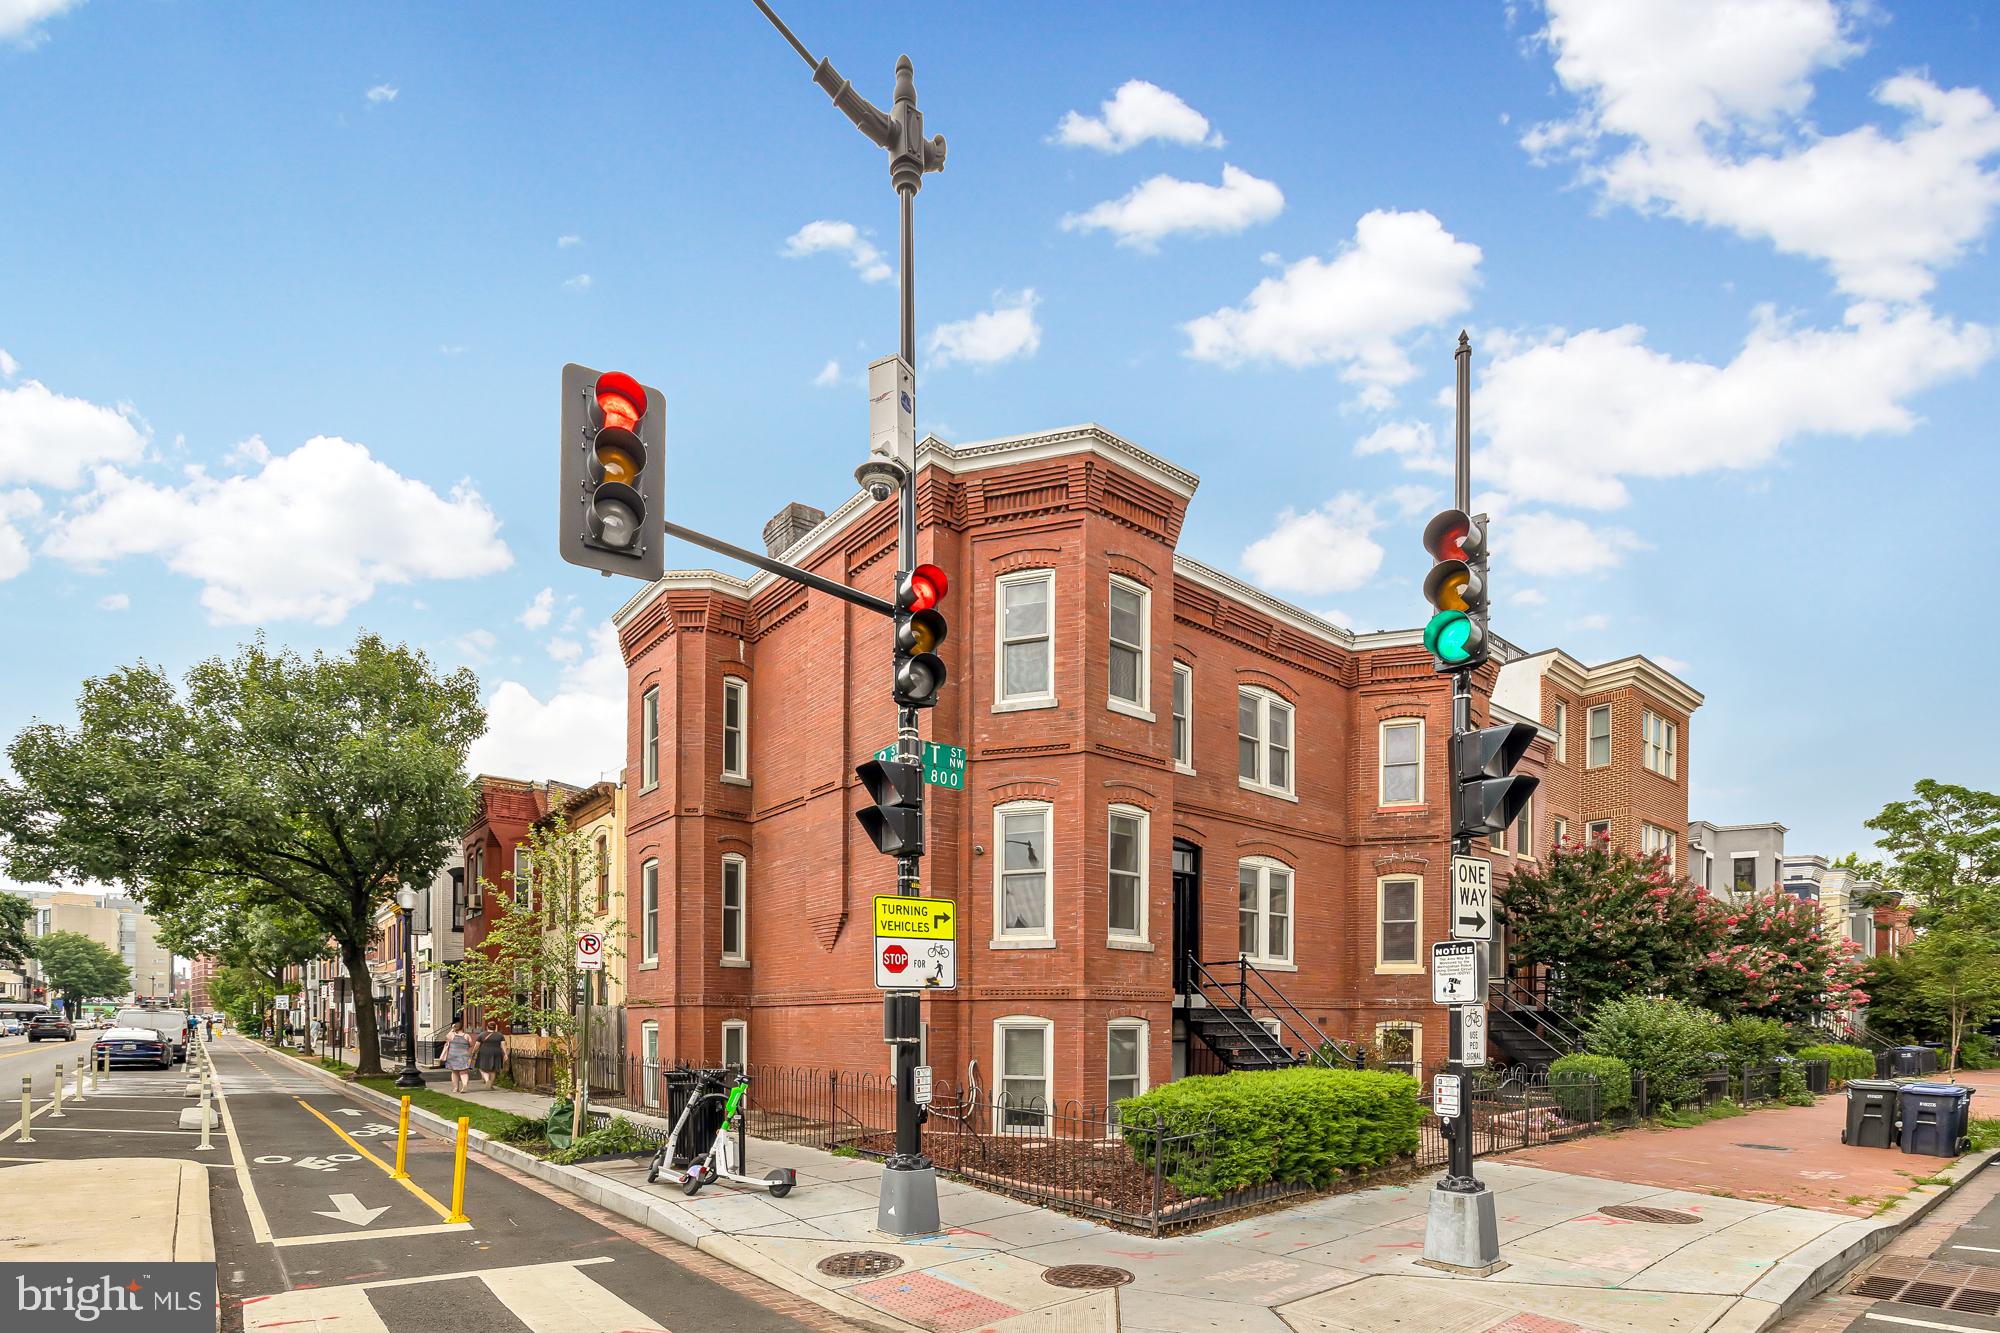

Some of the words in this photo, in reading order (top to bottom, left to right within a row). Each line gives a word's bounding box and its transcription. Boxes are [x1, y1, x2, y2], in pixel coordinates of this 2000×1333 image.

[931, 745, 940, 764] T
[951, 747, 962, 759] ST
[949, 758, 964, 769] NW
[930, 769, 958, 786] 800
[1459, 864, 1486, 884] ONE
[1459, 886, 1487, 907] WAY
[881, 903, 928, 917] TURNING
[880, 920, 930, 933] VEHICLES
[1436, 946, 1472, 955] NOTICE
[883, 953, 908, 965] STOP
[913, 959, 926, 968] FOR
[1469, 1031, 1478, 1039] USE
[1469, 1041, 1479, 1050] PED
[1466, 1052, 1482, 1060] SIGNAL
